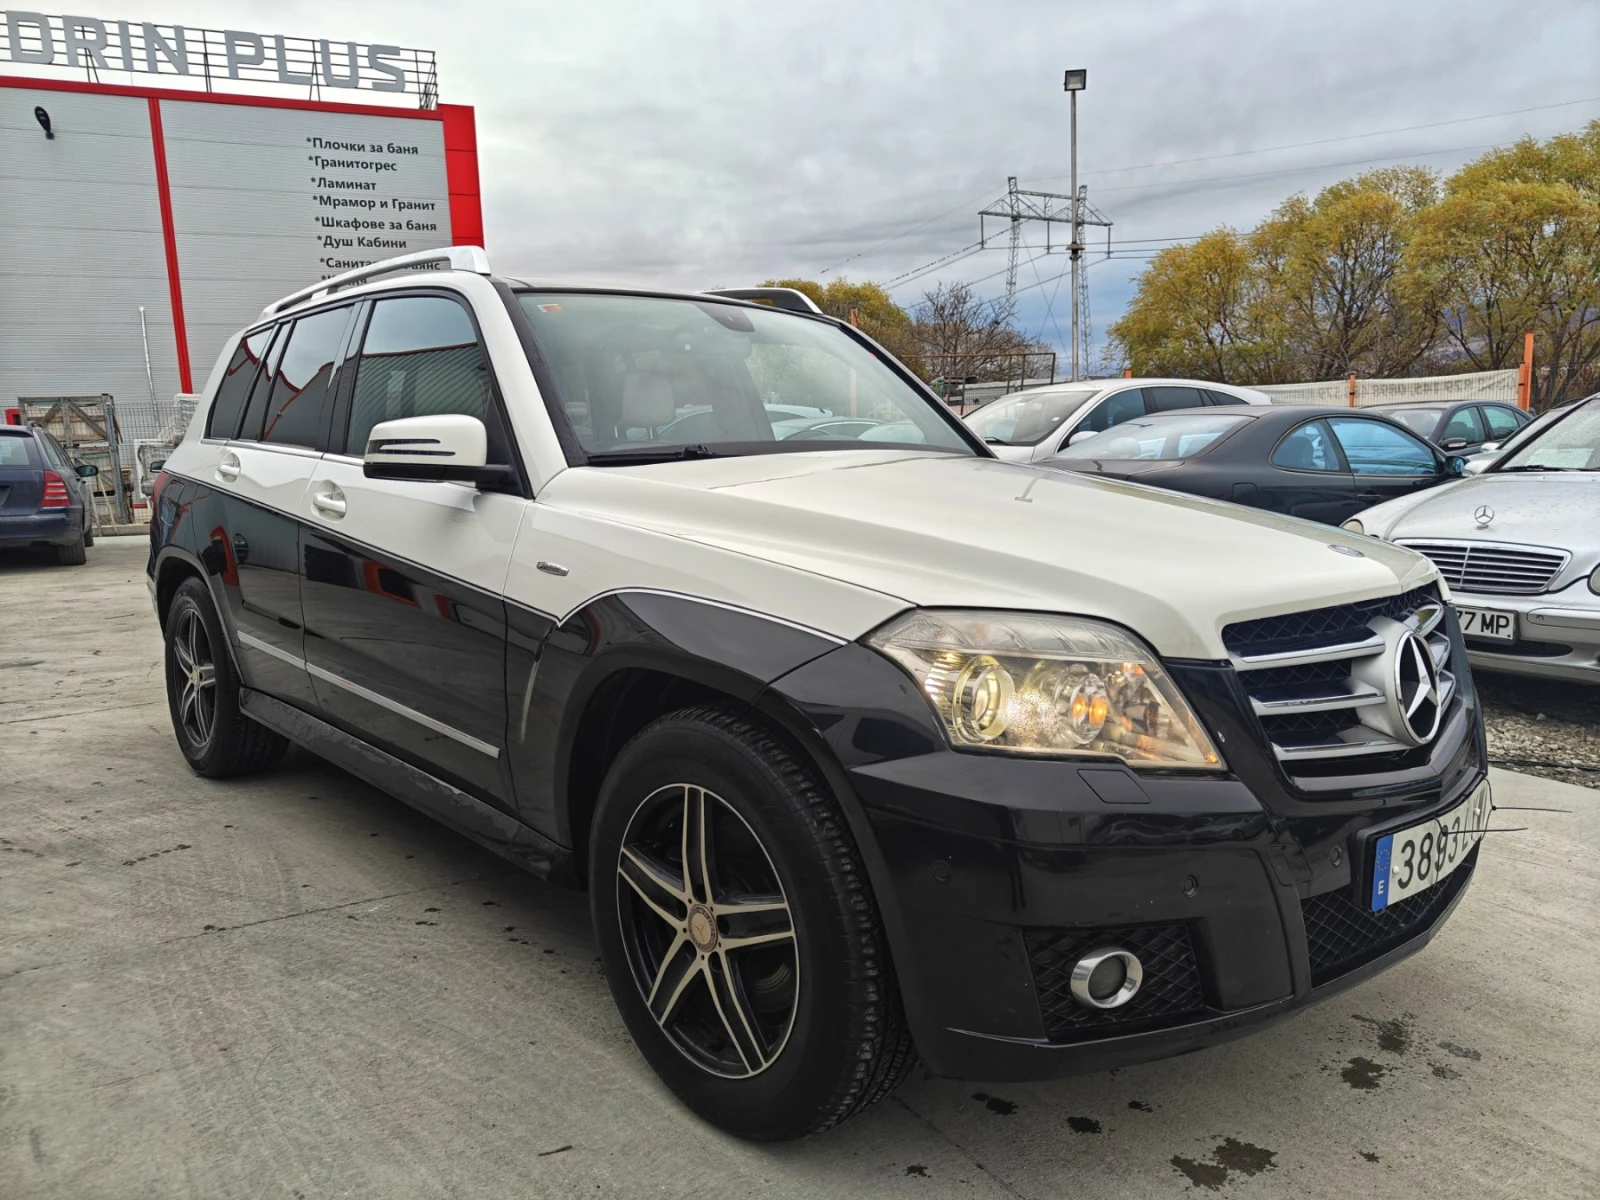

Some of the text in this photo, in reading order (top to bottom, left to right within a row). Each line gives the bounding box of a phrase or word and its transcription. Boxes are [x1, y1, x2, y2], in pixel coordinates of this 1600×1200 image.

[6, 10, 406, 93] DRIN PLUS
[369, 144, 383, 153] за
[387, 142, 419, 155] баня
[380, 200, 388, 209] и
[392, 199, 436, 212] Гранит
[388, 221, 403, 231] за
[406, 219, 437, 232] баня
[357, 236, 407, 249] Кабини
[1480, 612, 1510, 635] MP
[1377, 880, 1385, 895] E
